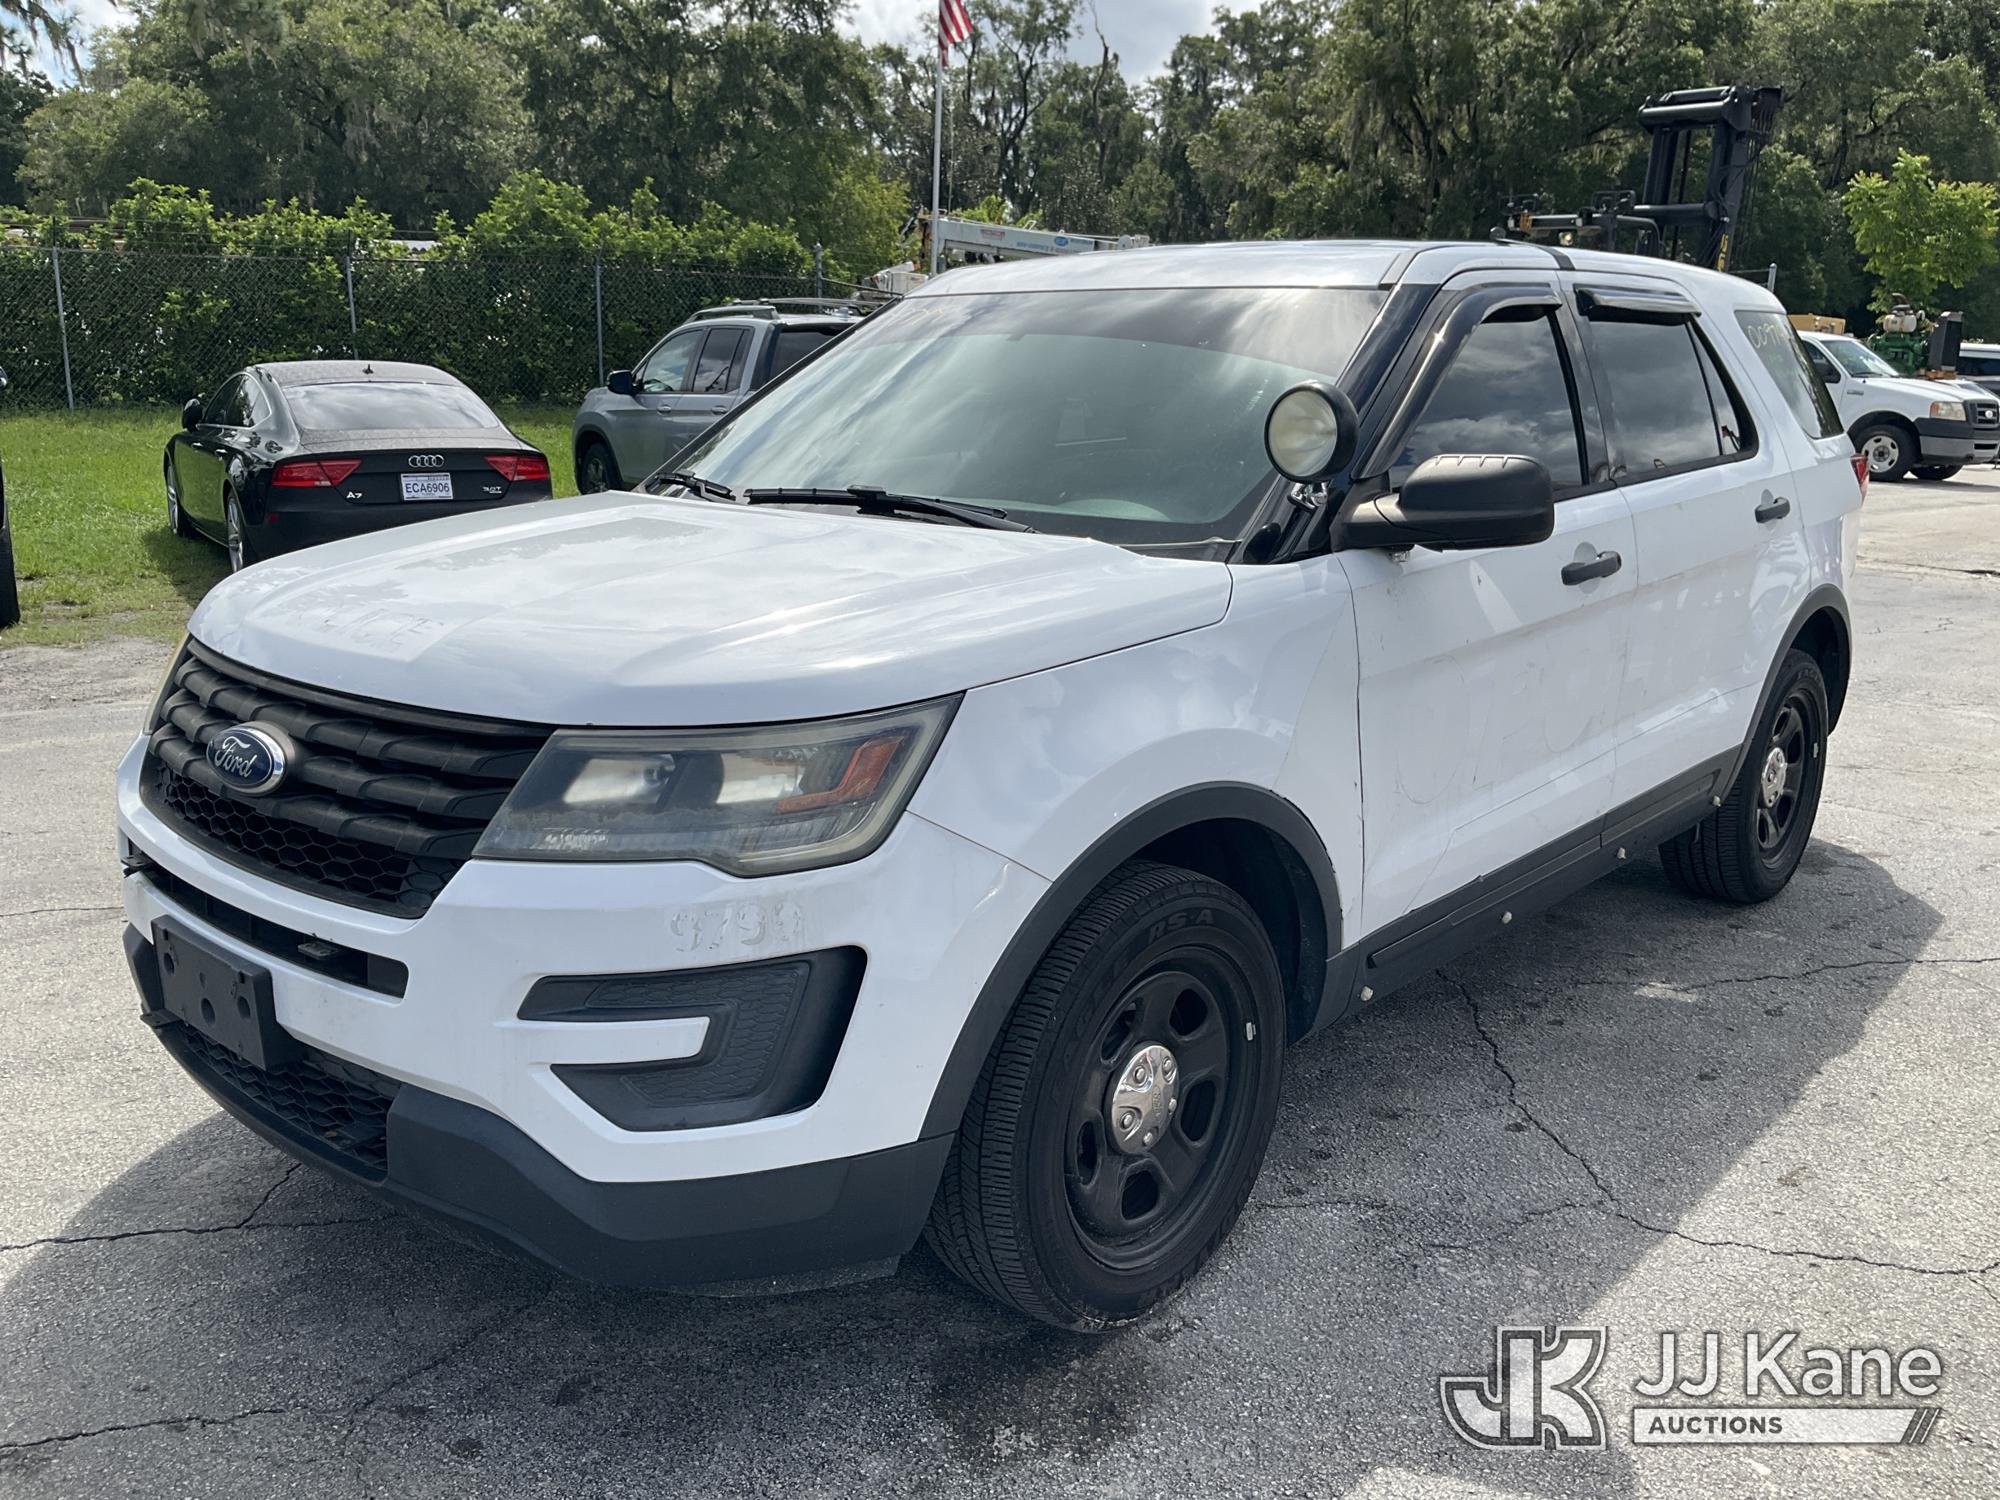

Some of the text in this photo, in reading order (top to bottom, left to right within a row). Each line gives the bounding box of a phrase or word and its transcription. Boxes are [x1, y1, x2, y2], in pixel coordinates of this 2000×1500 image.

[405, 483, 450, 493] ECA6906
[346, 491, 362, 499] A7
[214, 735, 258, 778] Ford
